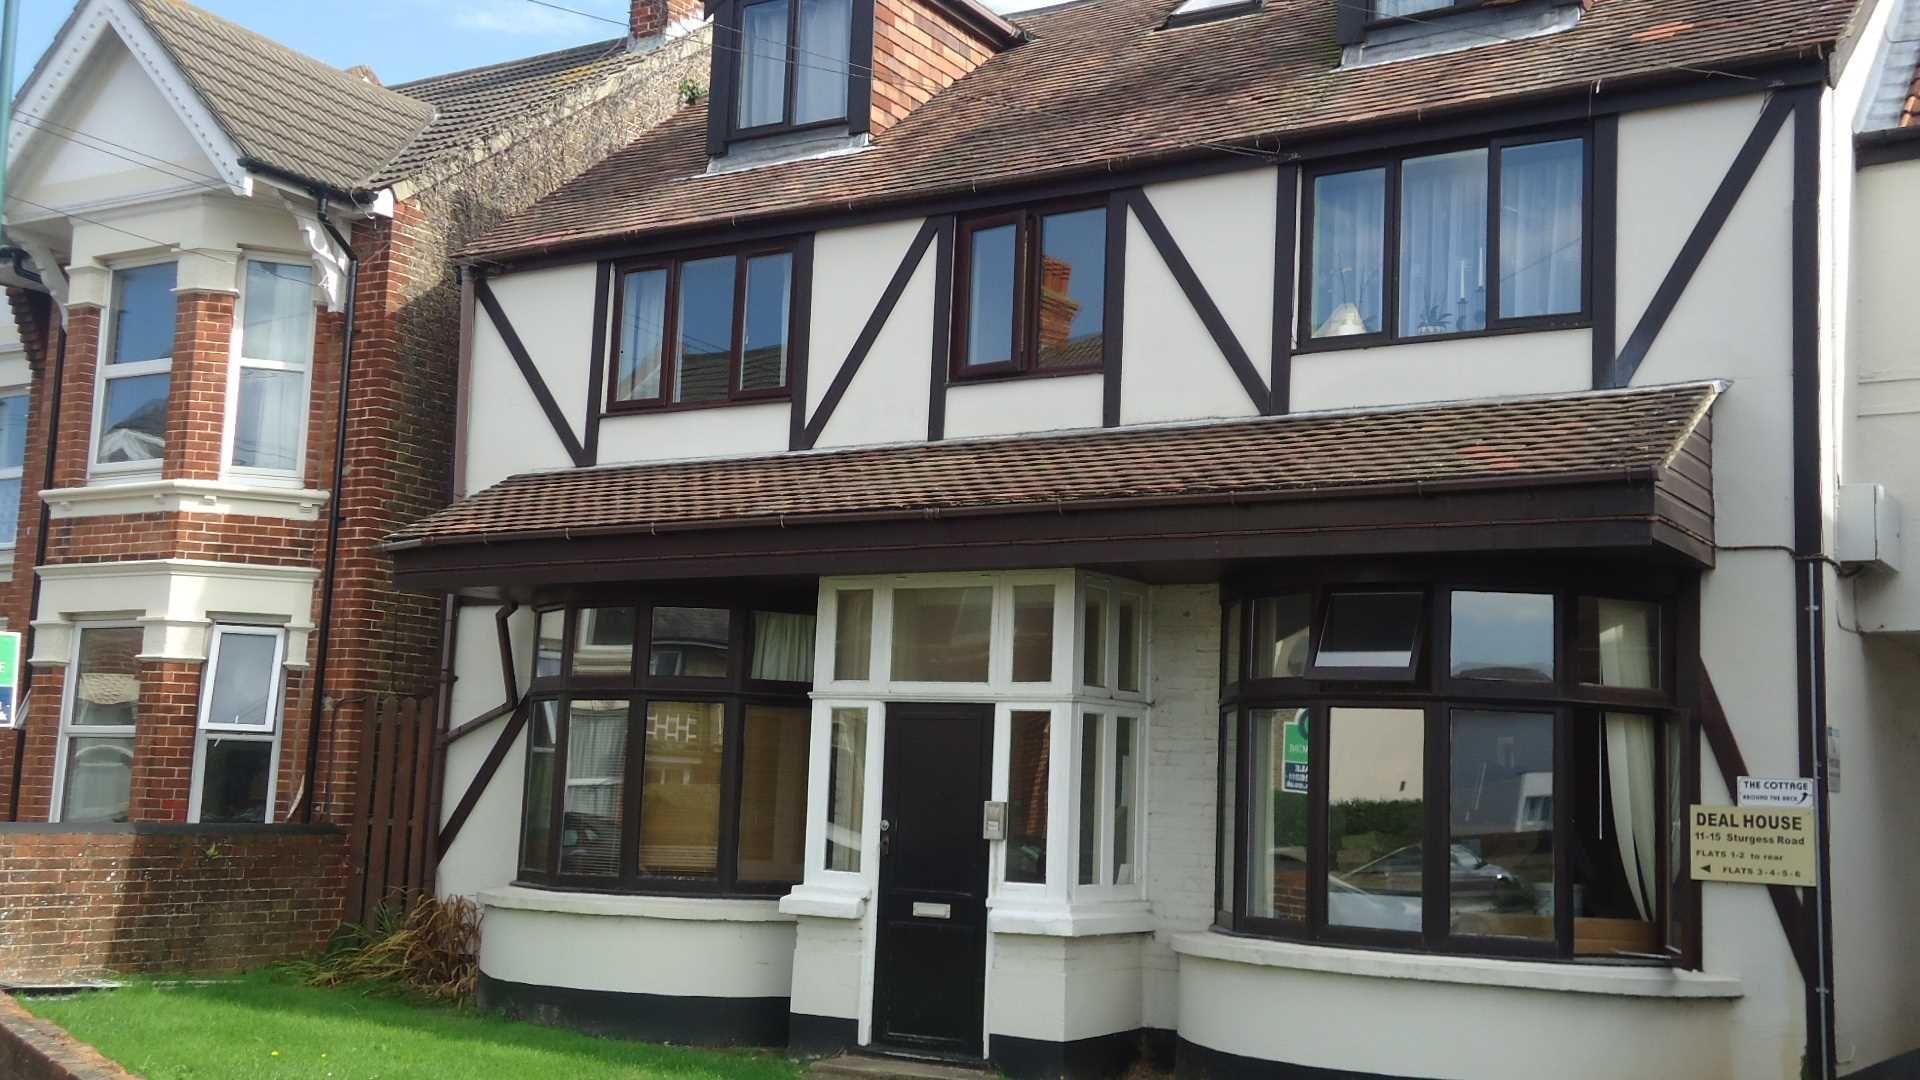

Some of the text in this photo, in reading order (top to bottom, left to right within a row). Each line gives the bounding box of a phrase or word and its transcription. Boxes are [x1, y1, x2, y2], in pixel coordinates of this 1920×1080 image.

[1744, 781, 1809, 791] THE COTTAGE
[1696, 813, 1802, 831] DEAL HOUSE
[1695, 832, 1805, 845] 11-15 Sturgess Road
[1696, 849, 1726, 858] FLATS
[1731, 851, 1745, 859] 1-2
[1722, 866, 1753, 875] FLATS
